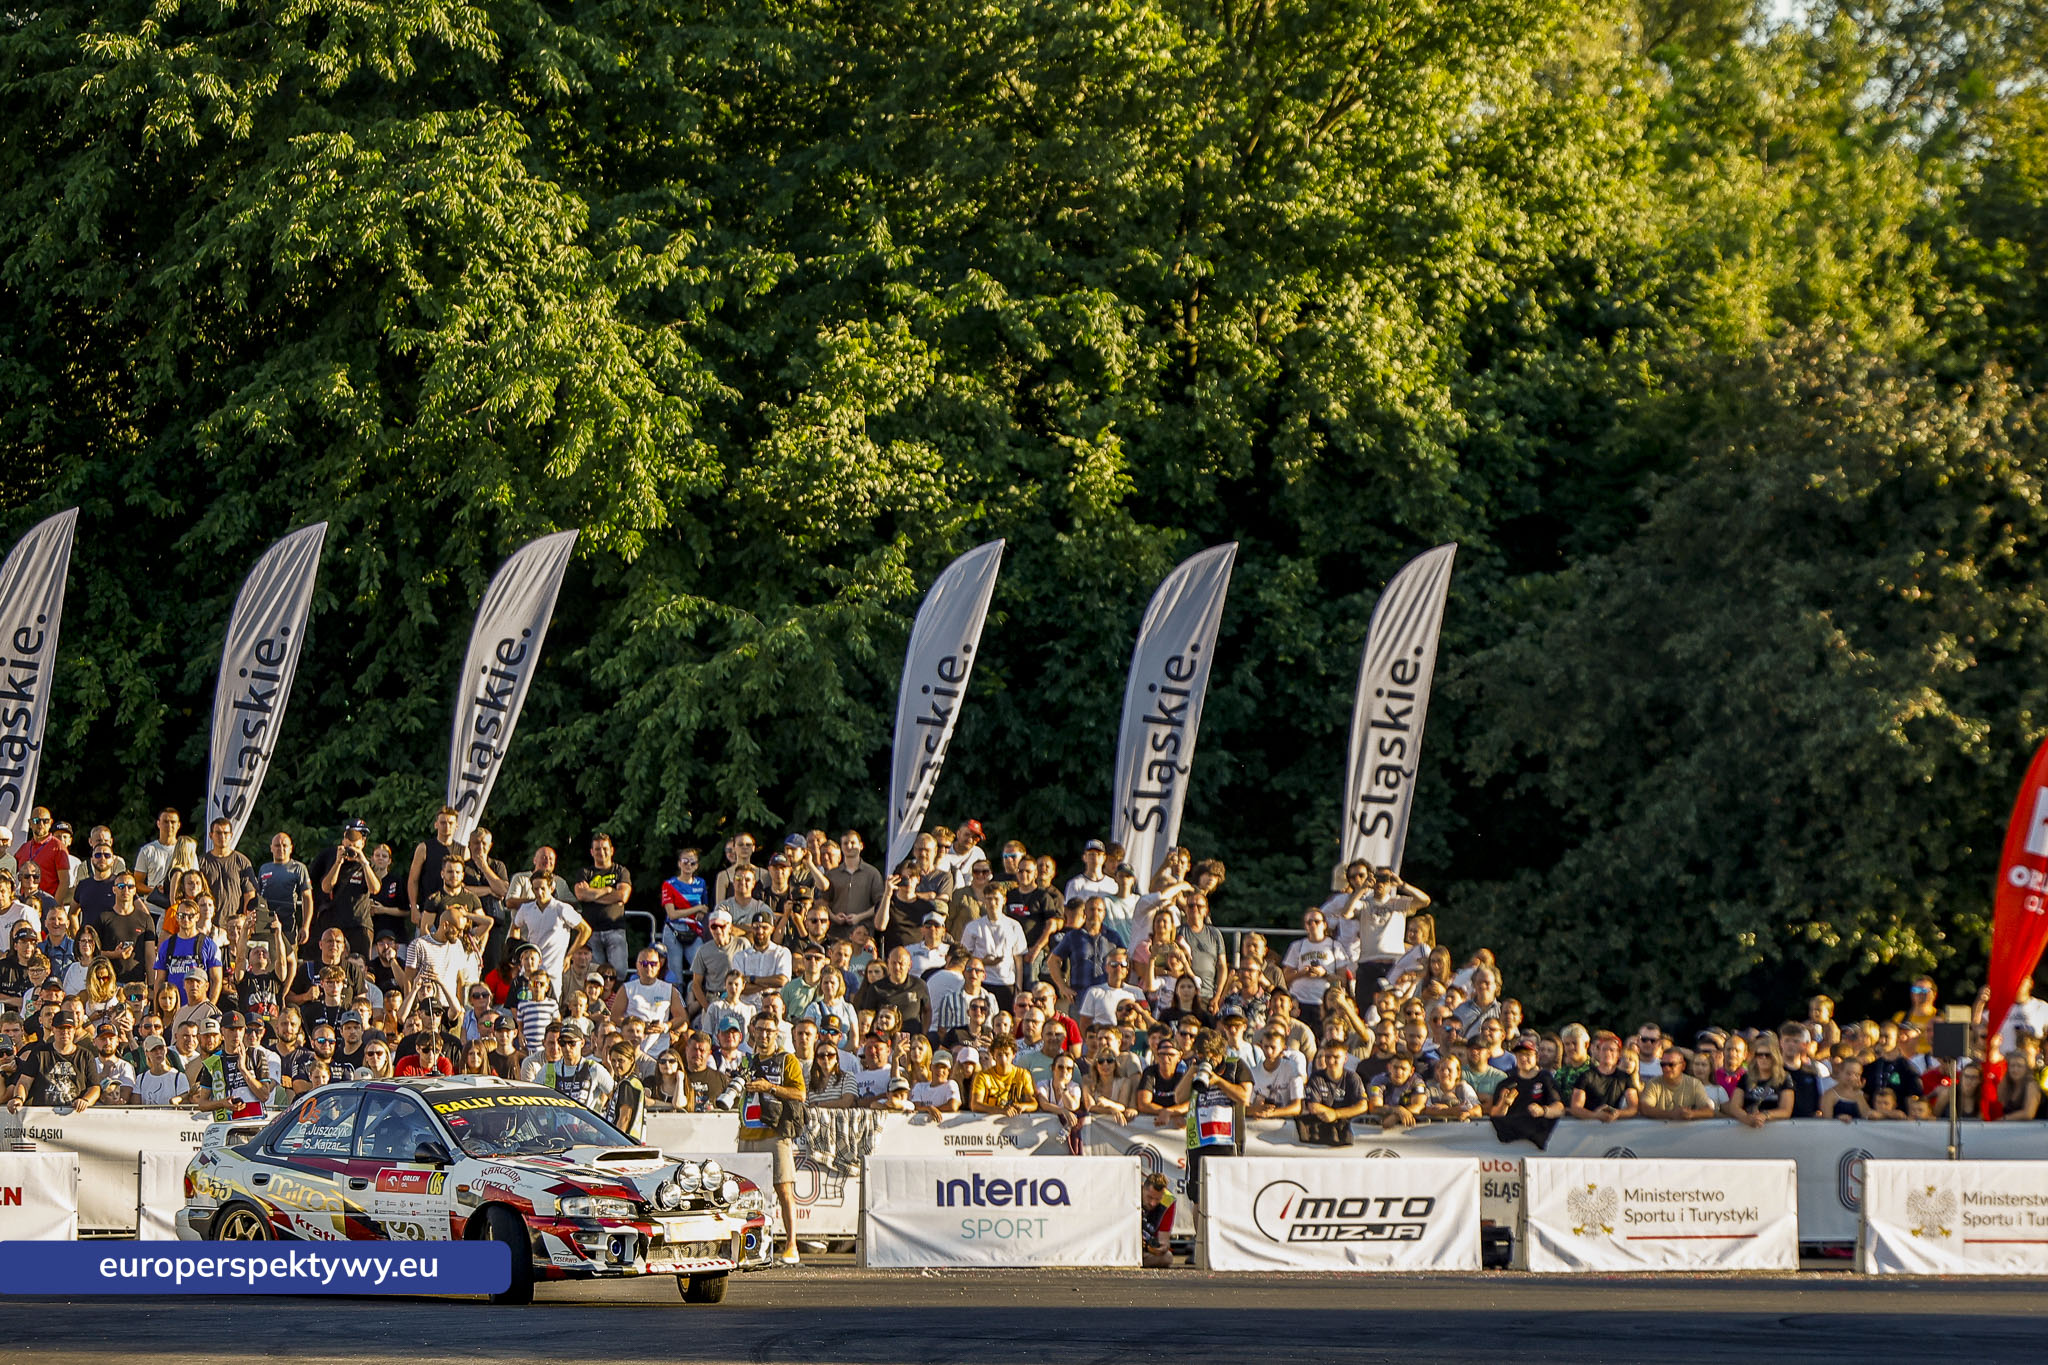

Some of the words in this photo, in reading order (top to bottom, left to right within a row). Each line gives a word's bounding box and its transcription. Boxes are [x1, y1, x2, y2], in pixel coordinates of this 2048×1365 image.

[1124, 643, 1200, 834] Śląskie.
[1352, 646, 1423, 839] Śląskie.
[433, 1096, 496, 1114] RALLY
[496, 1095, 588, 1110] CONTROL
[29, 1125, 63, 1142] ŚLĄSKI
[944, 1135, 983, 1147] STADION
[986, 1133, 1018, 1149] ŚLĄSKI
[937, 1173, 1071, 1207] interia
[1484, 1179, 1520, 1203] ŚLĄS
[1624, 1188, 1725, 1202] Ministerstwo
[1295, 1197, 1436, 1219] MOTO
[1624, 1208, 1675, 1225] Sportu
[1688, 1206, 1759, 1225] Turystyki
[961, 1218, 1048, 1239] SPORT
[1963, 1210, 2014, 1228] Sportu
[1290, 1224, 1425, 1240] WIZJA
